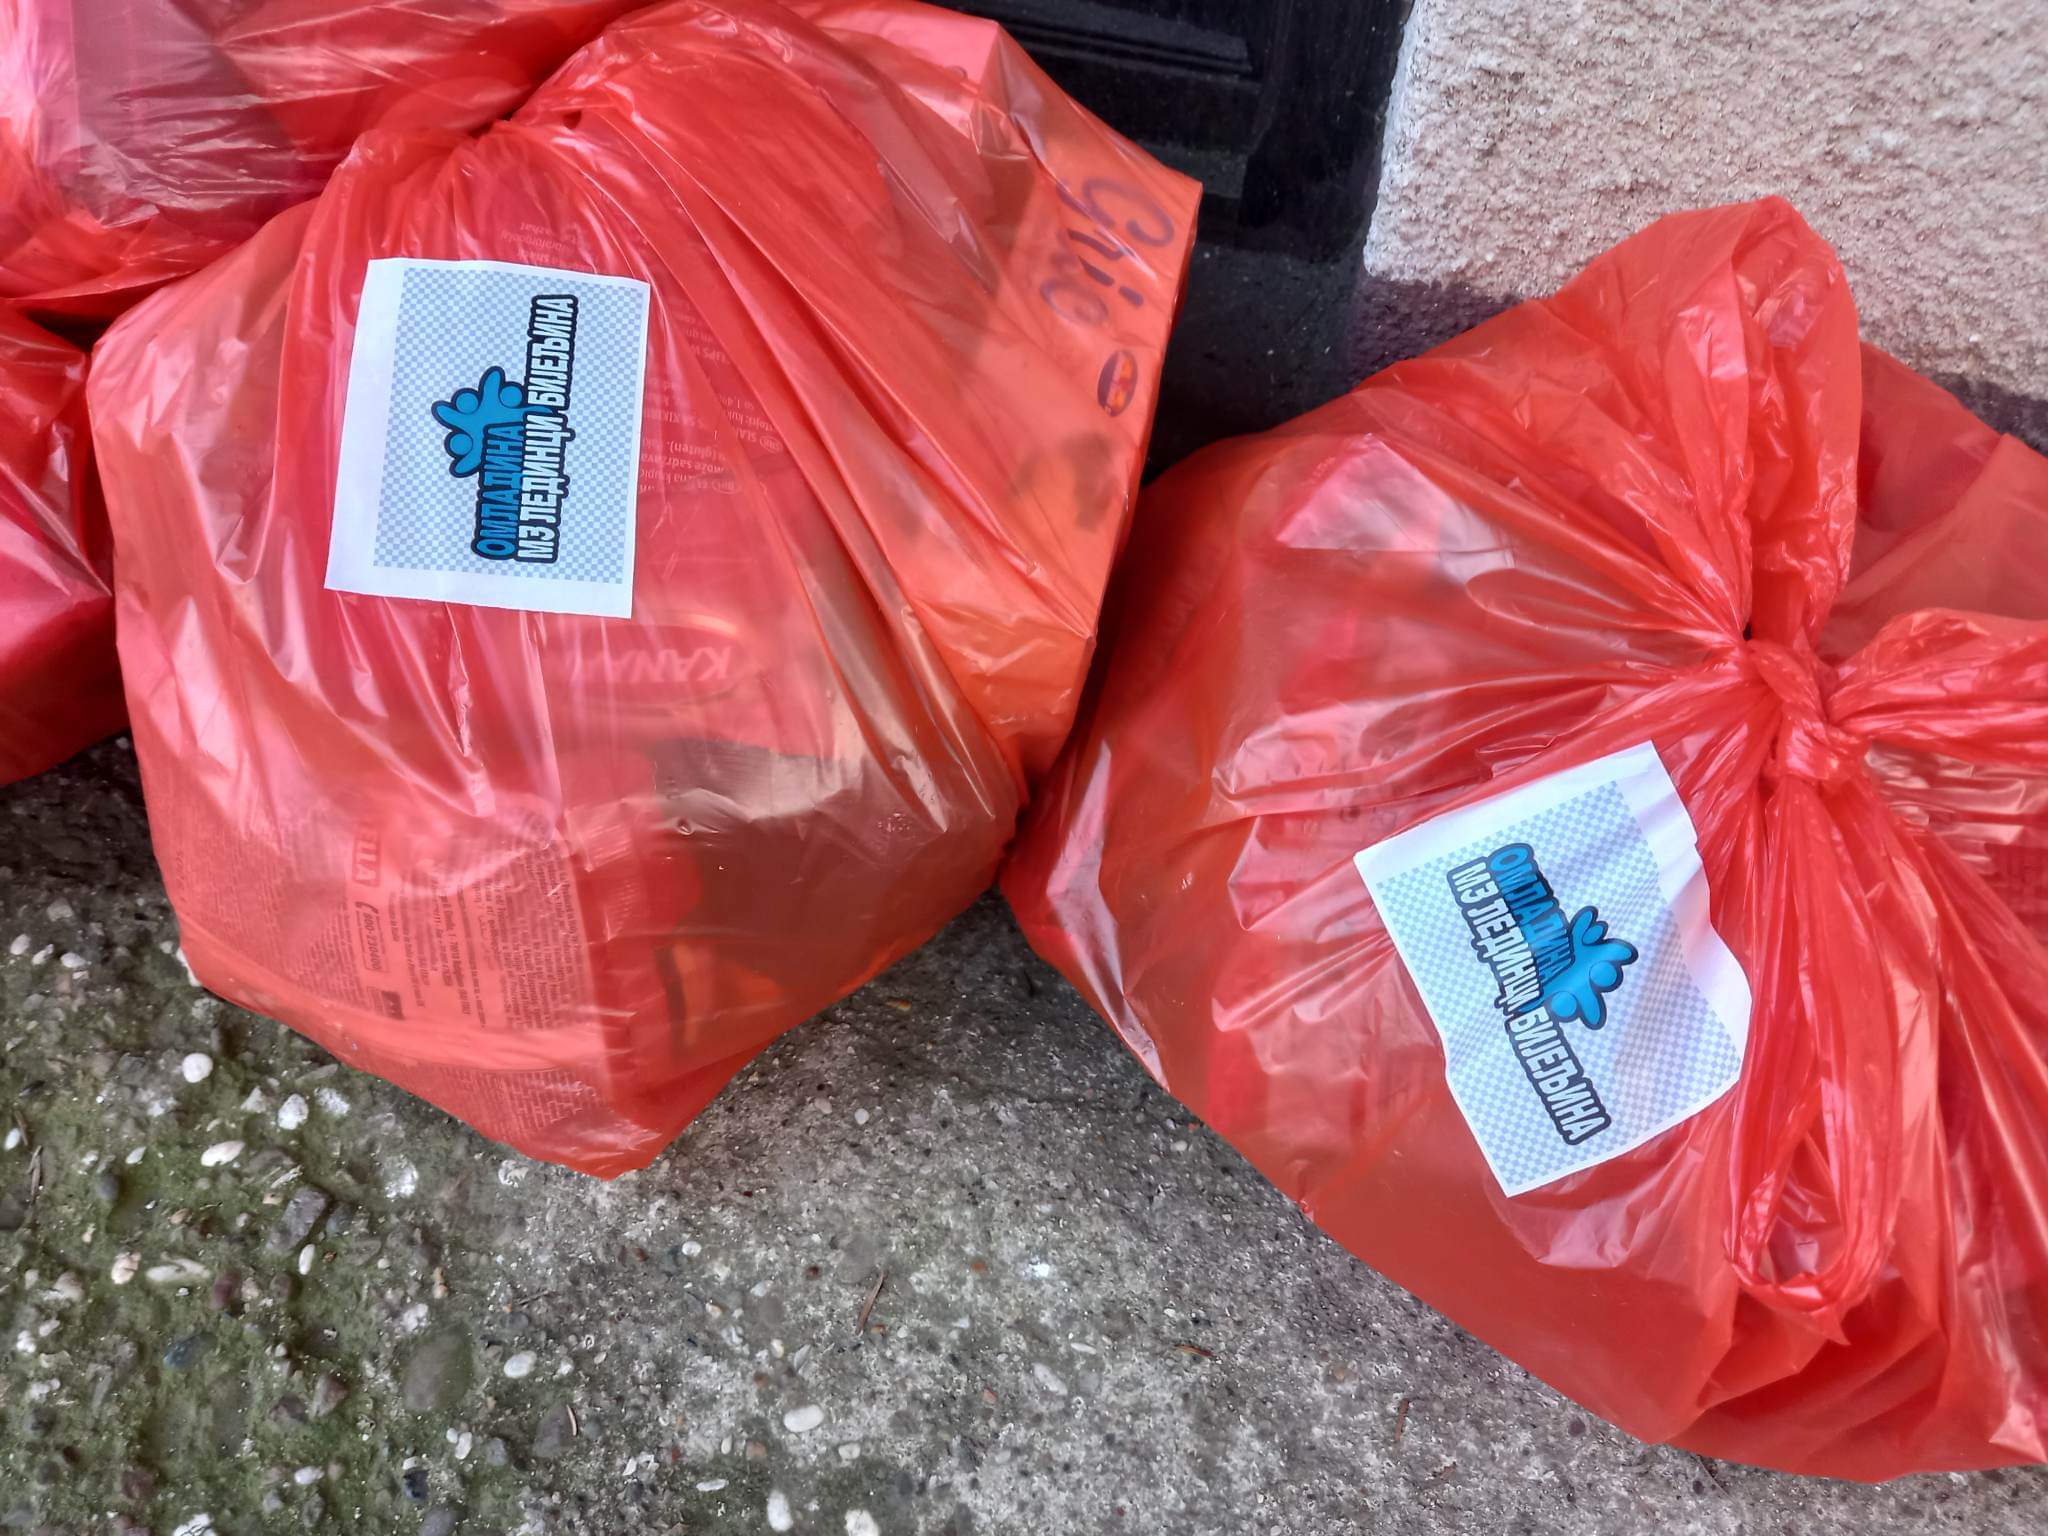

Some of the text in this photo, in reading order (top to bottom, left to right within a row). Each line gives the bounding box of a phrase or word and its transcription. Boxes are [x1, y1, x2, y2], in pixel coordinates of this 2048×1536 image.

[527, 297, 575, 407] БИЈЕЉИНА
[476, 425, 524, 557] ОМЛАДИНА
[518, 412, 570, 523] ЛЕДИНЦИ
[521, 525, 555, 560] МЗ
[1489, 846, 1573, 987] ОМЛАДИНА
[1451, 861, 1606, 1140] МЗ ЛЕДИНЦИ БИЈЕЉИНА
